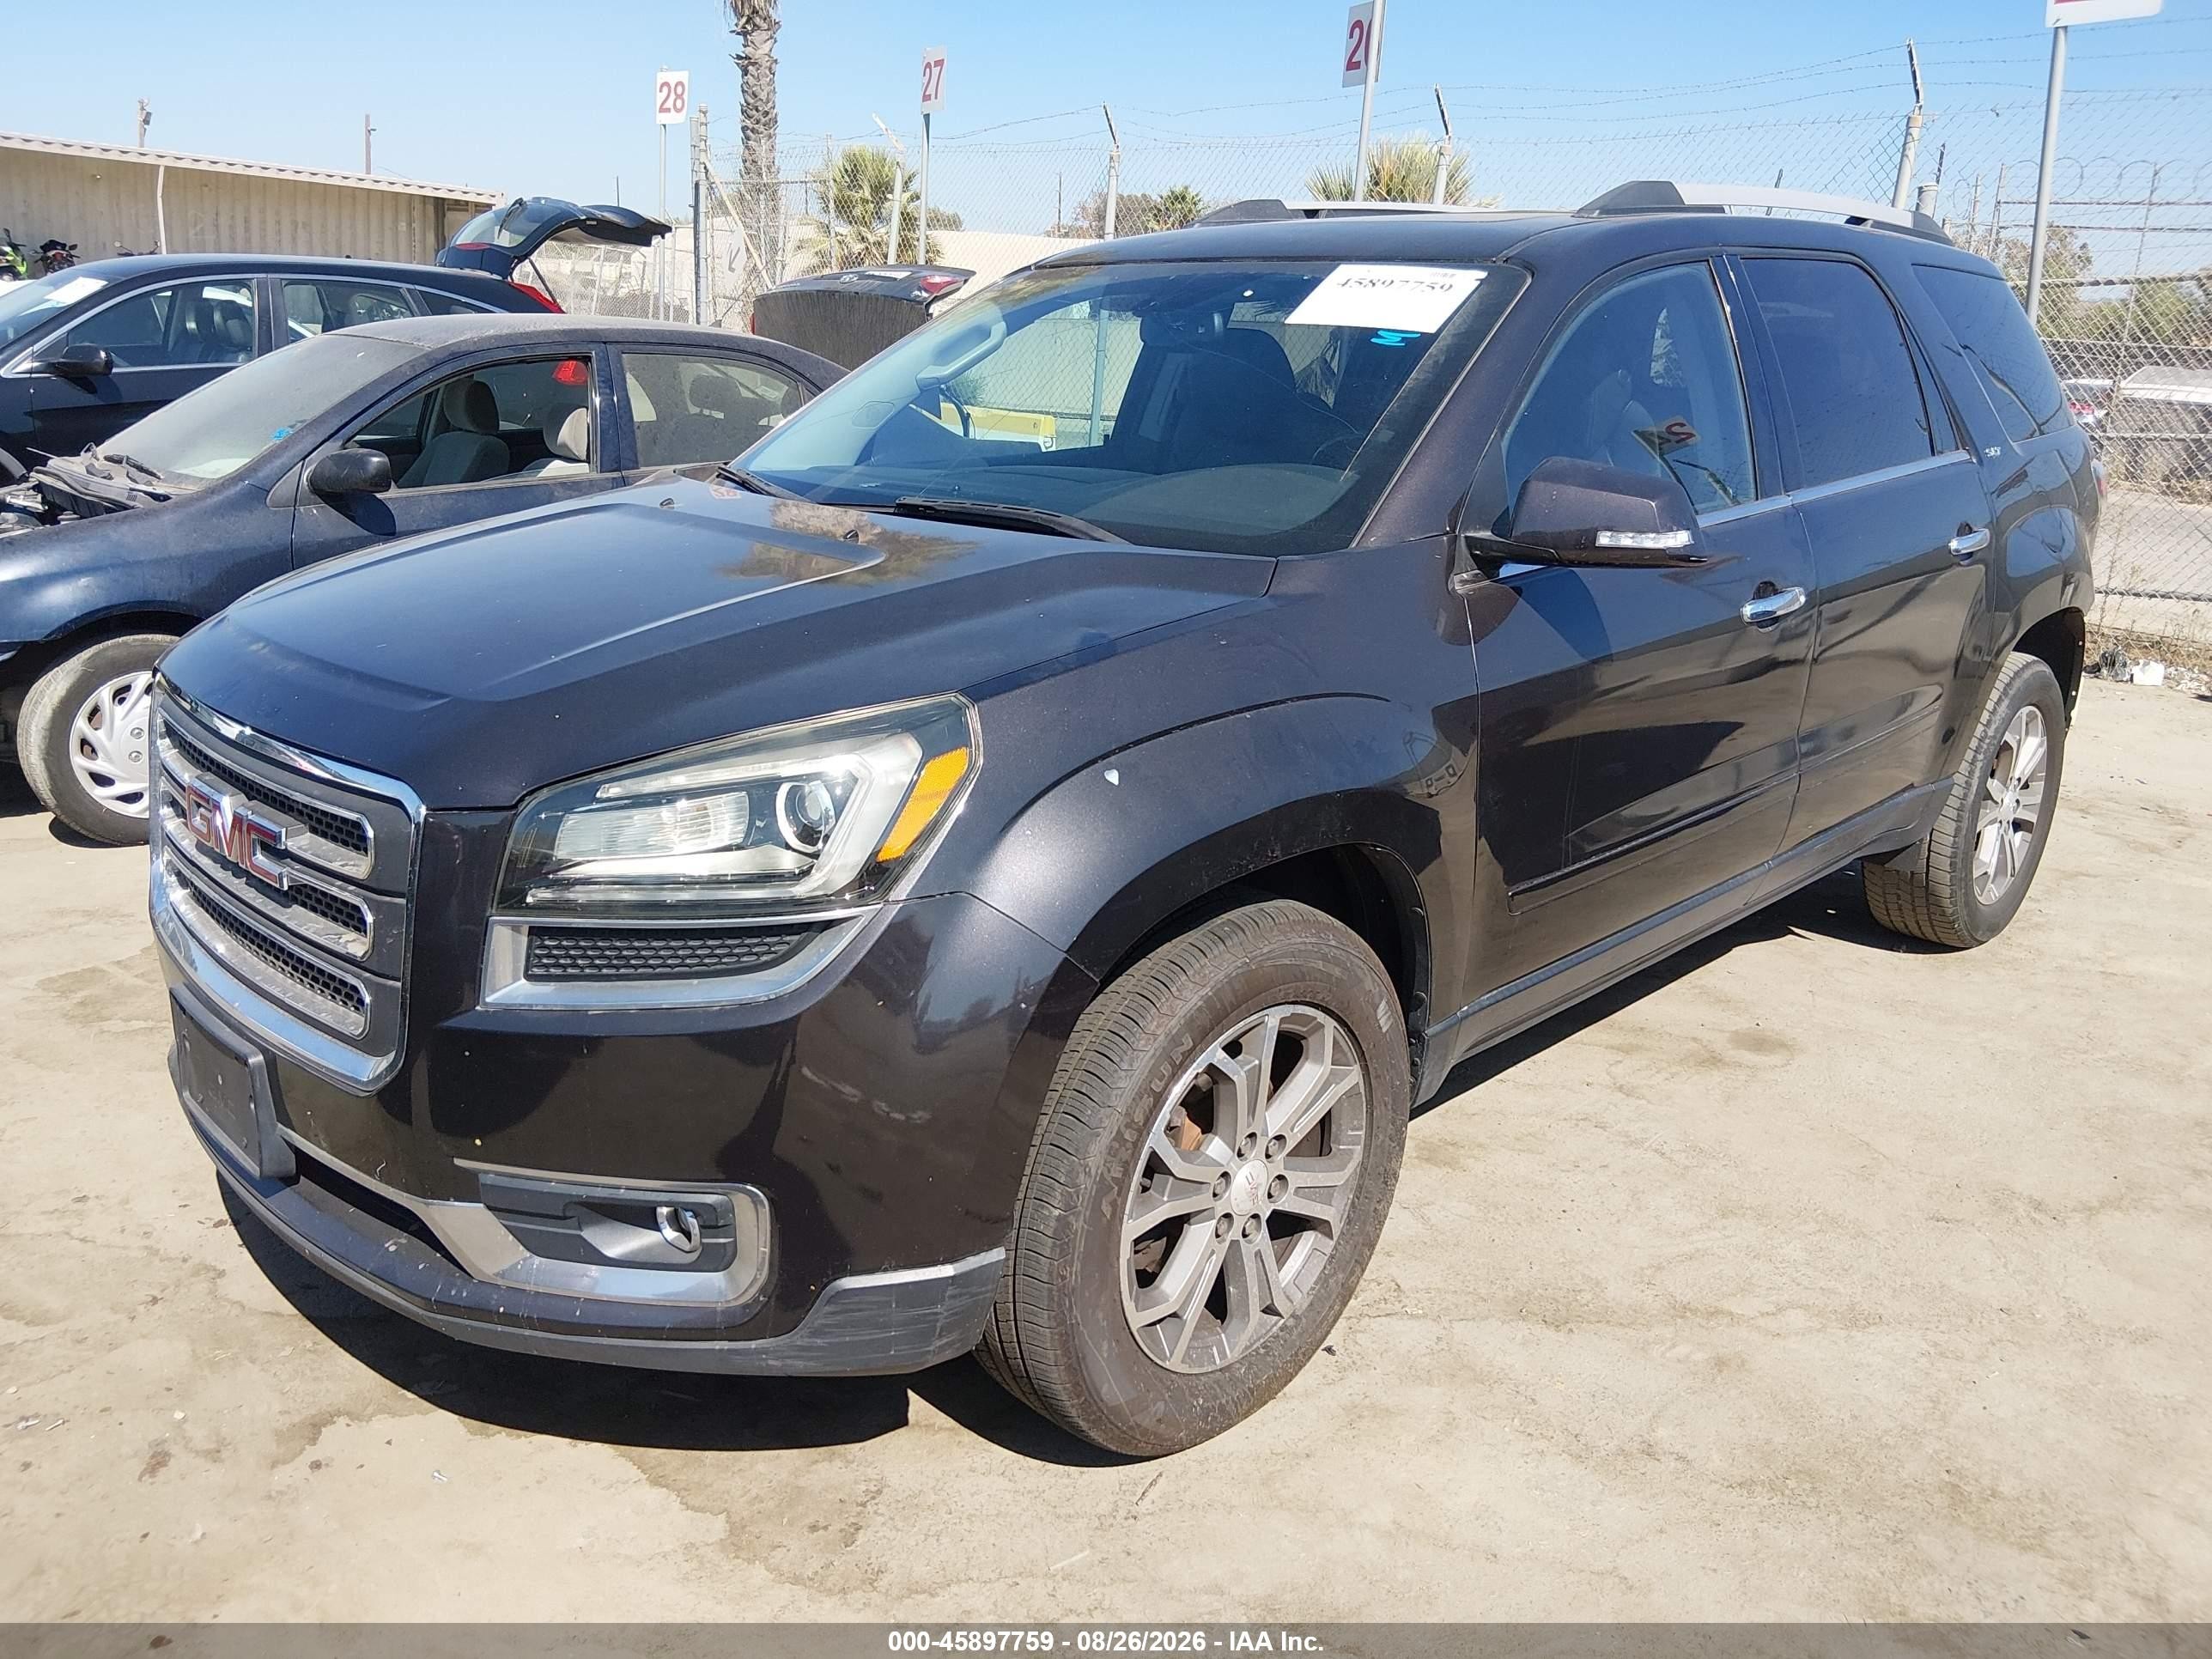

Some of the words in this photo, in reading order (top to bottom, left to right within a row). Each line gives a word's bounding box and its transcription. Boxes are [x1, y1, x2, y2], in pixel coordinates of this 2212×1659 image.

[659, 81, 685, 113] 28
[922, 58, 945, 102] 27
[185, 776, 289, 890] GMC
